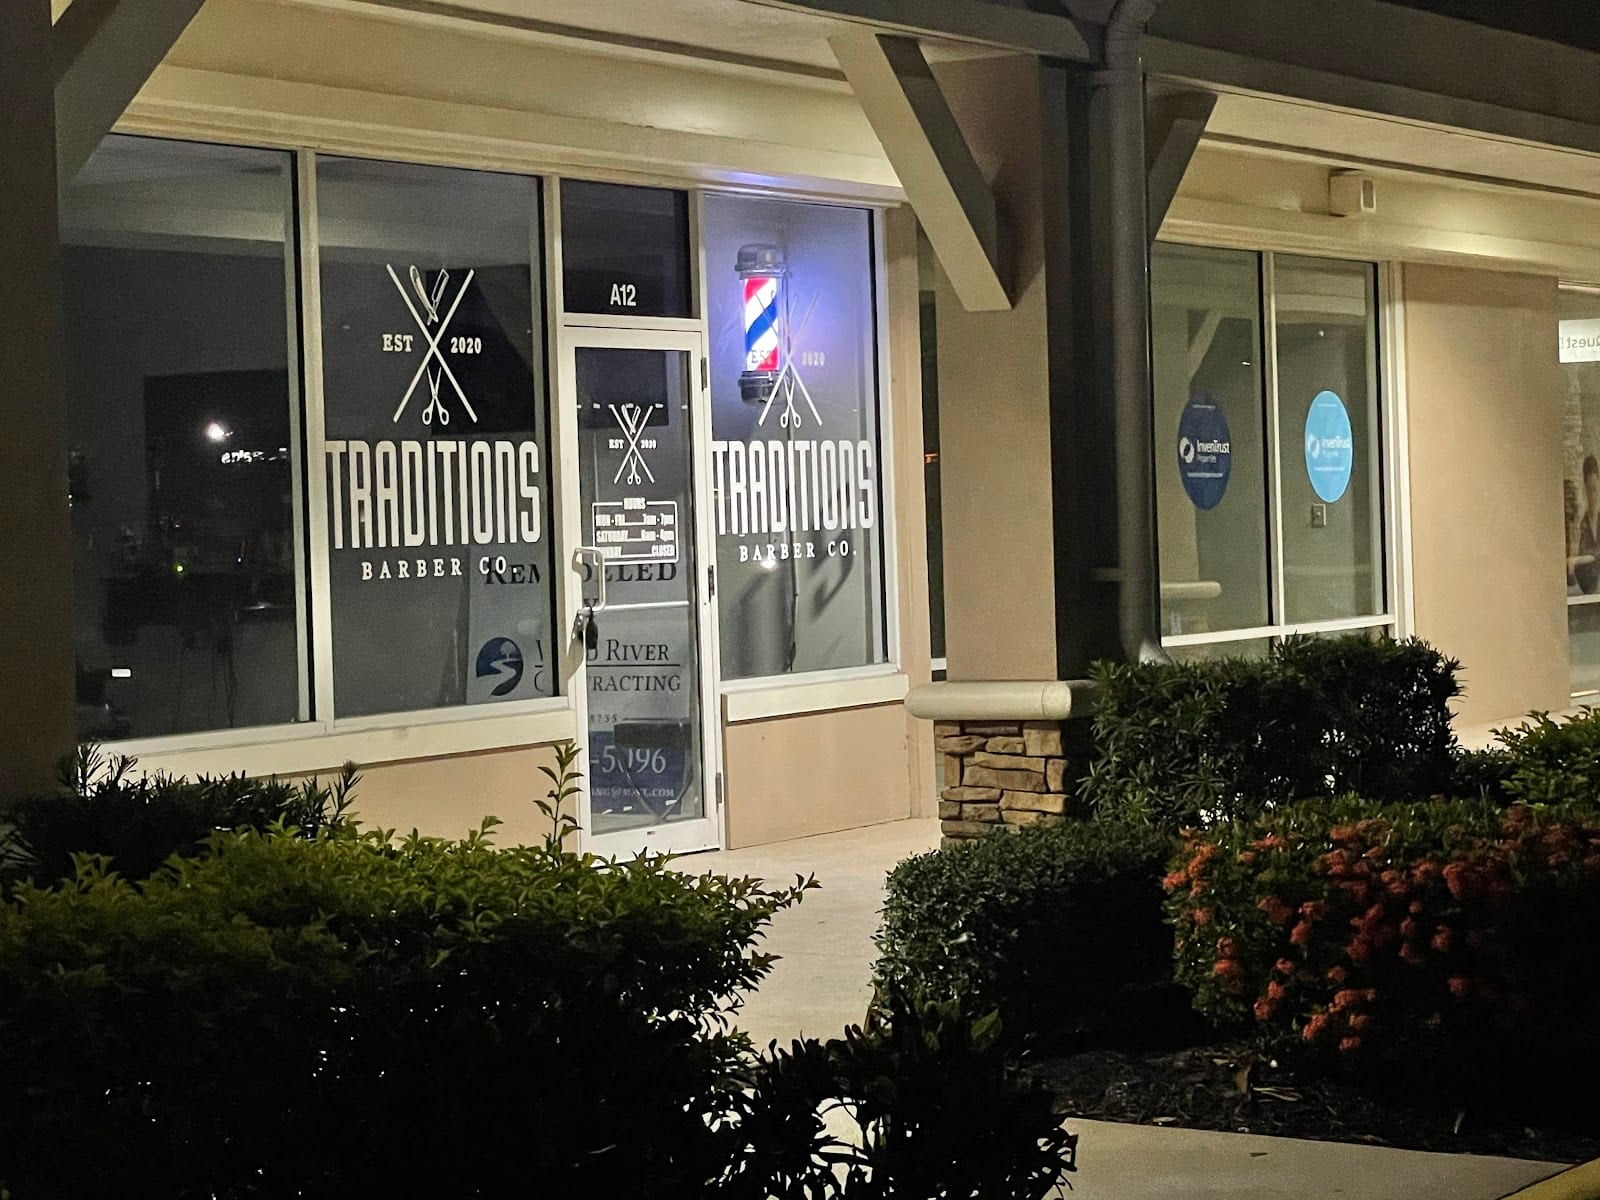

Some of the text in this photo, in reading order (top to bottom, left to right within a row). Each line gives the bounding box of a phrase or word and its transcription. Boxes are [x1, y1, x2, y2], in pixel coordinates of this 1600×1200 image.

[610, 284, 637, 307] A12
[382, 334, 482, 354] EST 2020
[802, 352, 825, 366] 2020
[608, 439, 624, 449] EST
[326, 440, 541, 549] TRADITIONS
[712, 440, 874, 535] TRADITIONS
[651, 544, 675, 557] CLOSED
[739, 540, 857, 562] BARBER CO.
[361, 555, 518, 581] BARBER CO.
[606, 639, 669, 661] RIVER
